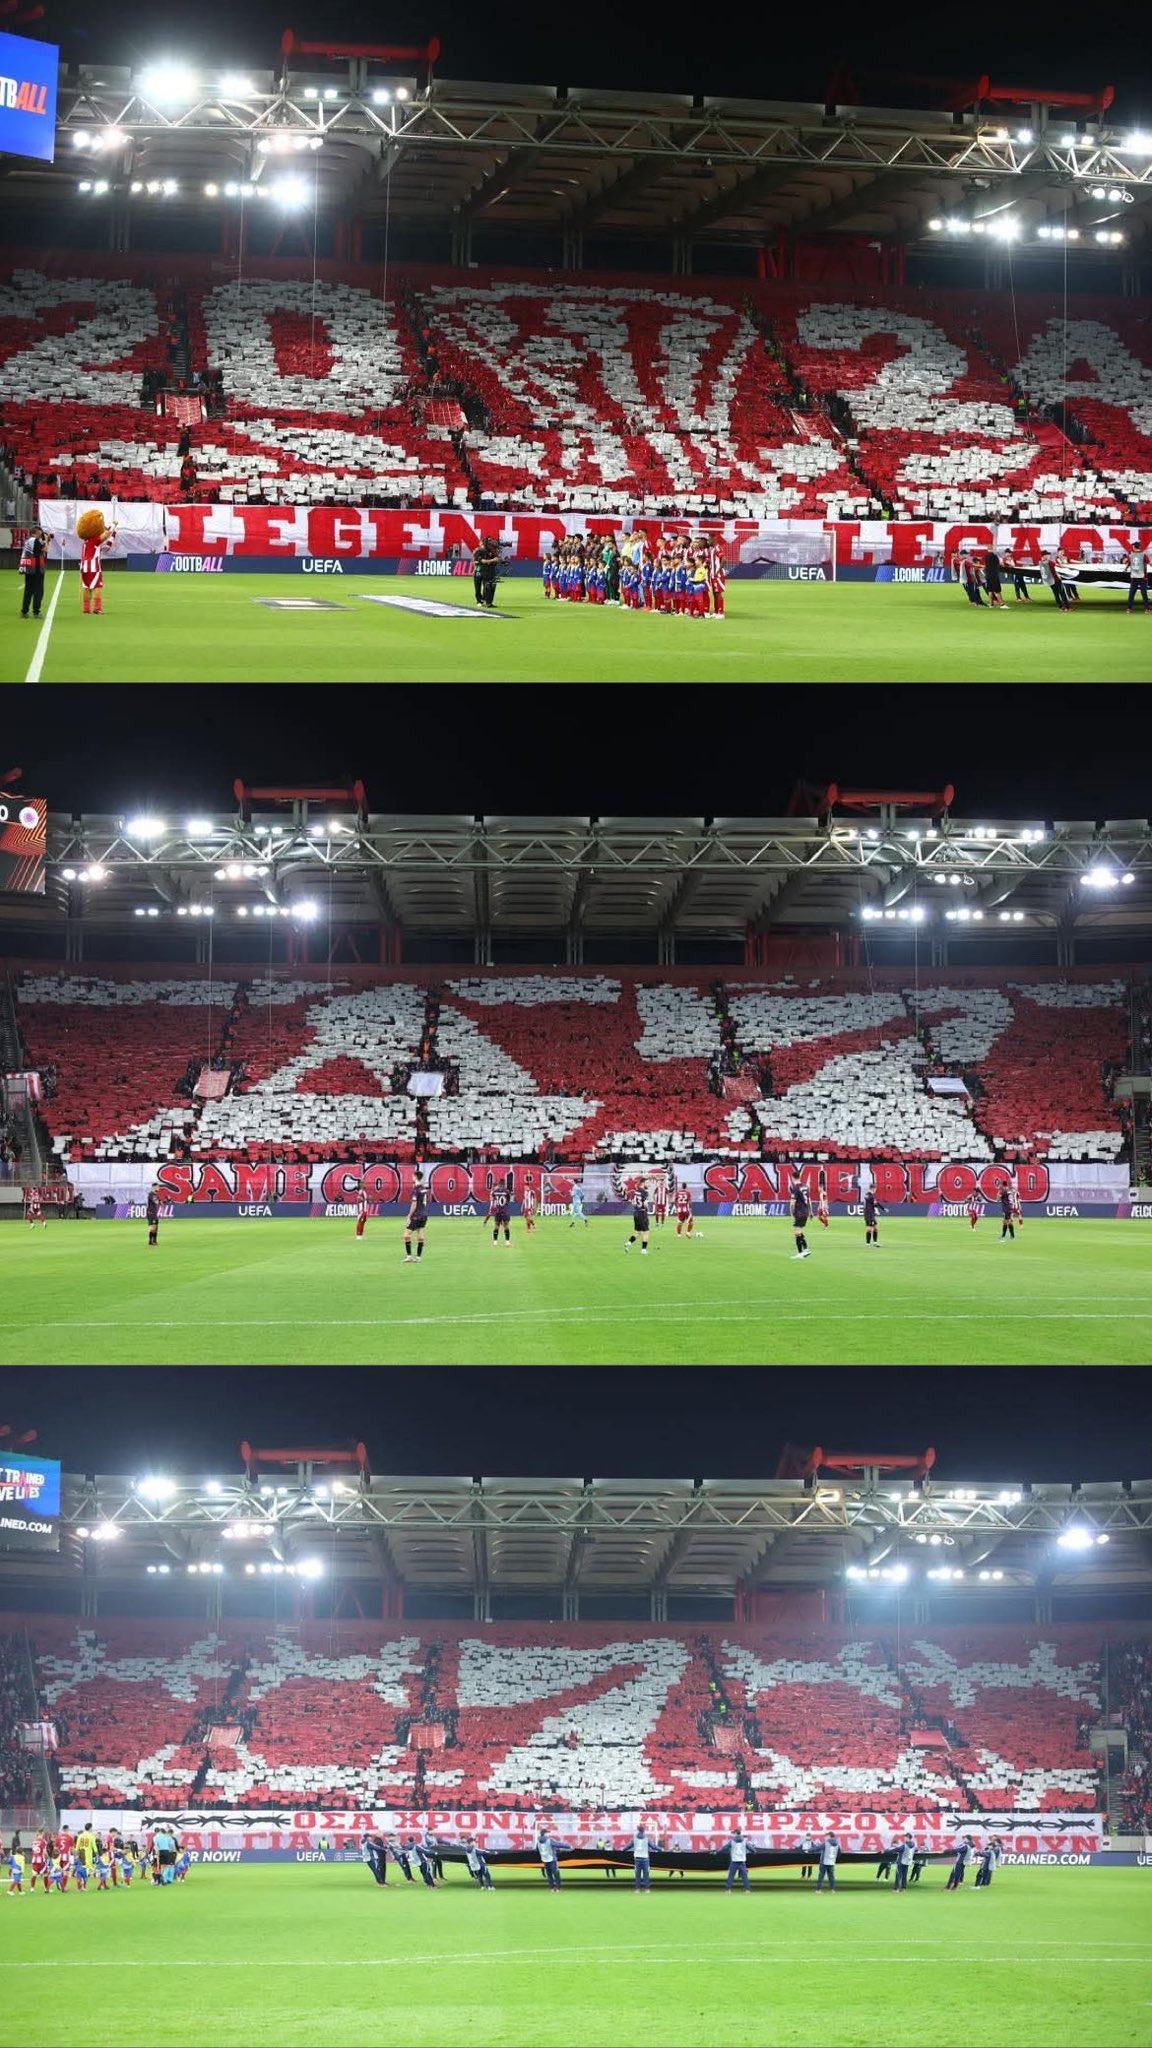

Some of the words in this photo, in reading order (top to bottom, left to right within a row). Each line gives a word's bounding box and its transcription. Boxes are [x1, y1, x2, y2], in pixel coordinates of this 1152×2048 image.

[302, 559, 343, 573] UEFA
[415, 560, 452, 576] LCOME
[788, 567, 826, 581] UEFA
[892, 567, 925, 582] LCOME
[926, 568, 946, 582] ALL
[156, 1163, 313, 1203] SAME
[321, 1163, 584, 1203] COLOURS
[704, 1163, 860, 1203] SAME
[869, 1163, 1050, 1203] BLOOD
[238, 1205, 272, 1216] UEFA
[325, 1203, 359, 1216] ELCOM
[443, 1204, 477, 1216] UEFA
[767, 1203, 786, 1216] ALL
[847, 1205, 880, 1216] UEA
[1046, 1205, 1079, 1217] UEFA
[5, 1468, 46, 1485] TRAINED
[294, 1811, 379, 1830] ΟΣΑ
[394, 1811, 558, 1830] ΧΡΟΝΙΑ
[577, 1813, 621, 1831] ΚΙ
[639, 1812, 696, 1831] ΑΝ
[711, 1812, 943, 1831] ΠΕΡΑΣΟΥΝ
[203, 1851, 241, 1862] NOW!
[296, 1851, 327, 1862] UEFA
